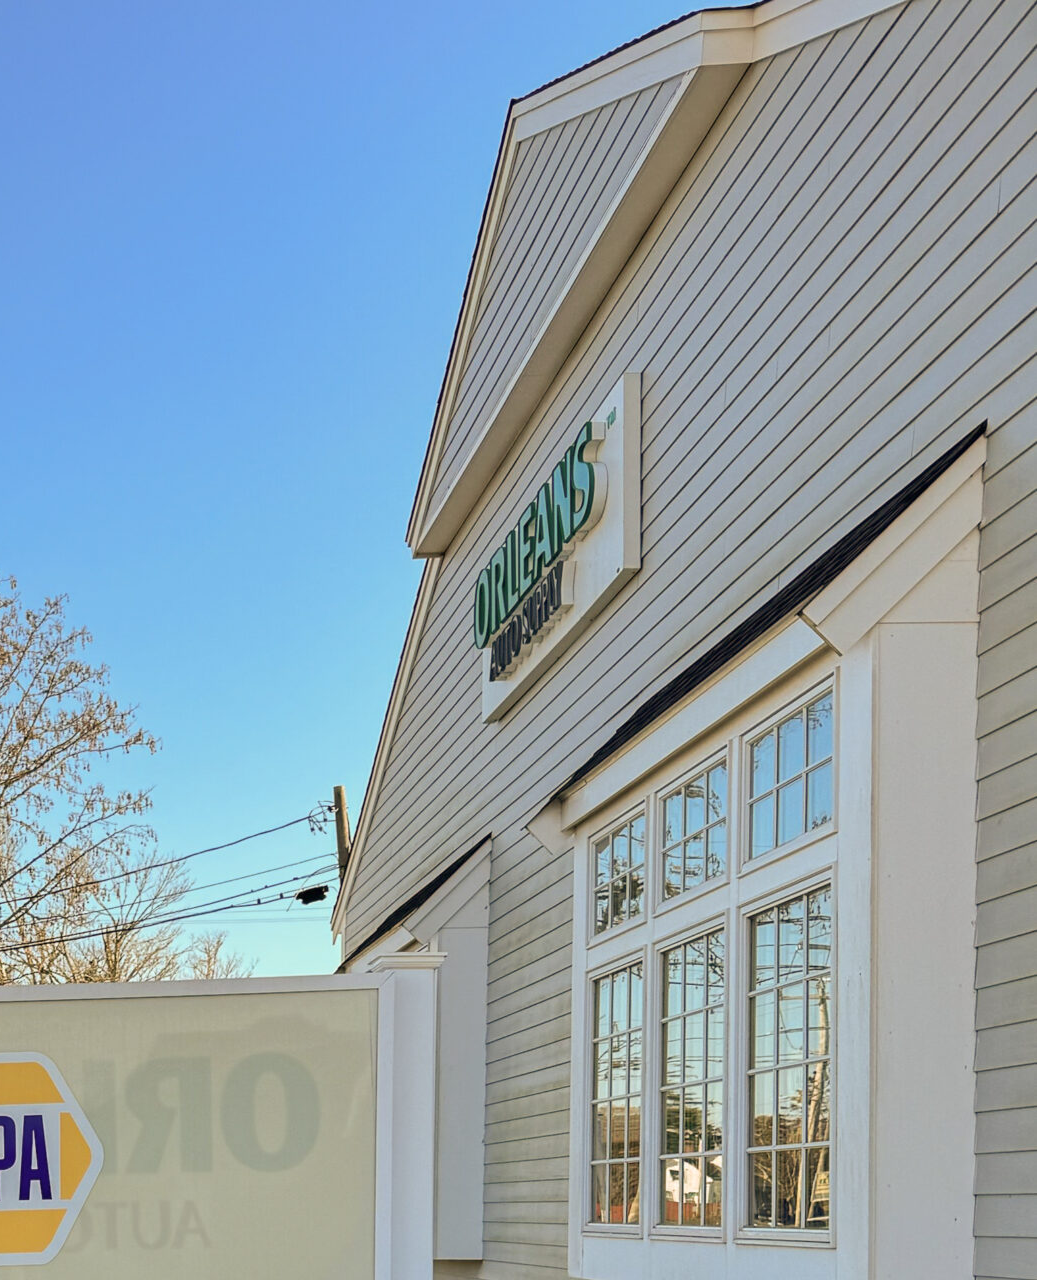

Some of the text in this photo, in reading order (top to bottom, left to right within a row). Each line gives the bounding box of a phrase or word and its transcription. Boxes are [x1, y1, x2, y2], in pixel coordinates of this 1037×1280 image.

[474, 421, 595, 649] ORLEANS
[489, 560, 563, 682] AUTO SUPPLY
